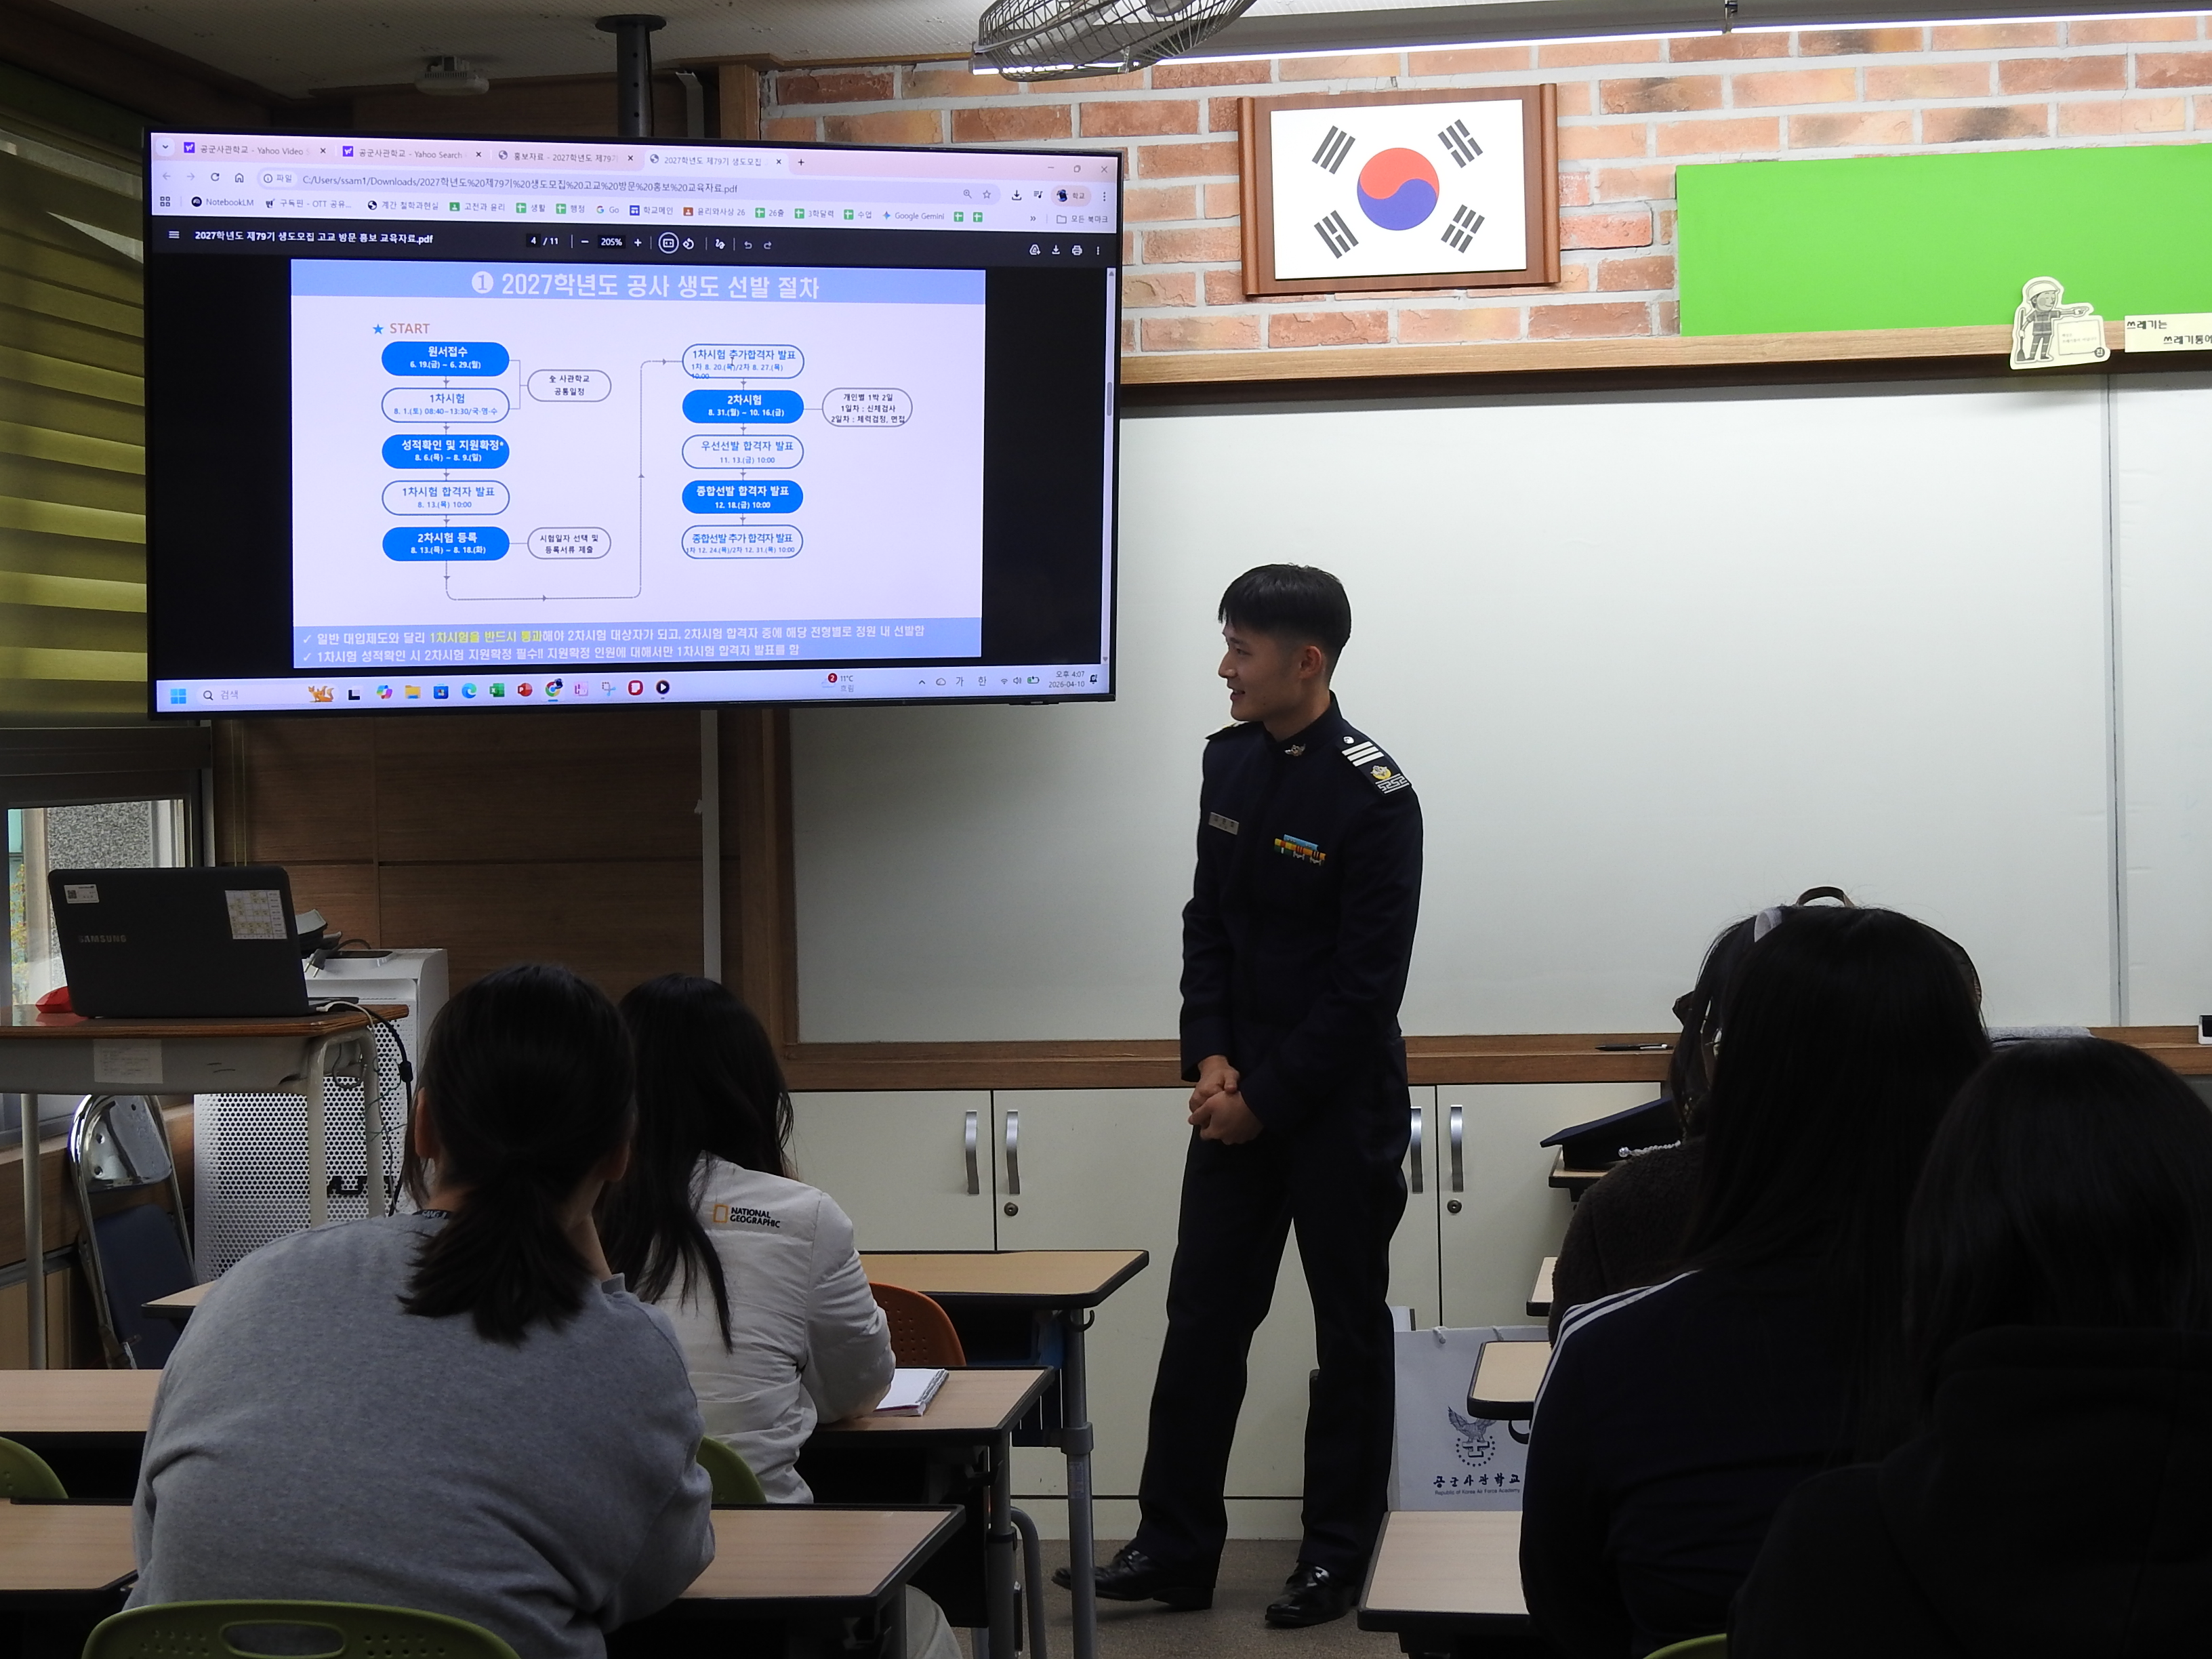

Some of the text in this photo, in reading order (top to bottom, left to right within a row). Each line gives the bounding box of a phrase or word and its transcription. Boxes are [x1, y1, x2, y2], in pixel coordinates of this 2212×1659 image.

[201, 145, 248, 155] 공군사관학교
[359, 149, 462, 159] 공군사관학교 Yahoo Search
[514, 152, 592, 163] 홍보자료 2027학년도
[665, 157, 761, 167] 2027학년도 제79기 생도모집
[276, 174, 291, 183] 파일
[382, 201, 397, 209] 계간
[644, 207, 673, 215] 학교메인
[895, 212, 919, 222] Google
[1088, 216, 1108, 224] 북마크
[195, 230, 433, 245] 2027학년도 제79기 생도모집 고교 방문 홍보 교육자료.pdf
[601, 238, 622, 246] 205%
[502, 272, 819, 300] 2027학년도 공사 생도 선발 절차
[390, 323, 430, 333] START
[2127, 320, 2167, 329] 쓰레기는
[428, 346, 468, 358] 원서접수
[693, 349, 796, 360] 1차시험 추가합격자 발표
[560, 375, 590, 383] 사관학교
[554, 388, 584, 396] 공통일정
[430, 393, 465, 404] 1차시험
[728, 394, 762, 405] 2차시험
[891, 415, 905, 424] 면접
[402, 440, 442, 451] 성적확인
[446, 440, 455, 451] 및
[701, 441, 794, 451] 우선선발 합격자 발표
[403, 487, 495, 497] 1차시험 합격자 발표
[697, 485, 789, 497] 종합선발 합격자 발표
[417, 532, 477, 544] 2차시험 등록
[693, 533, 727, 544] 종합선발
[748, 533, 774, 544] 합격자
[776, 533, 793, 544] 발표
[317, 633, 340, 645] 일반
[344, 632, 400, 645] 대입제도와
[404, 632, 425, 644] 달리
[430, 632, 480, 644] 1차시험을
[484, 630, 516, 642] 반드시
[520, 630, 565, 642] 통과해야
[568, 630, 606, 642] 2차시험
[611, 629, 653, 641] 대상자가
[684, 628, 722, 640] 2차시험
[726, 628, 758, 639] 합격자
[762, 627, 782, 639] 중에
[786, 627, 807, 638] 해당
[857, 626, 876, 638] 정원
[881, 626, 890, 637] 내
[895, 625, 924, 637] 선발함
[318, 651, 356, 663] 1차시험
[362, 650, 405, 663] 성적확인
[410, 650, 420, 661] 시
[425, 649, 464, 661] 2차시험
[469, 649, 512, 661] 지원확정
[548, 647, 590, 659] 지원확정
[595, 647, 626, 659] 인원에
[630, 646, 674, 658] 대해서만
[678, 645, 714, 657] 1차시험
[719, 645, 750, 657] 합격자
[754, 644, 785, 656] 발표를
[790, 644, 799, 655] 함
[956, 676, 964, 687] 가
[978, 676, 987, 687] 한
[840, 684, 854, 693] 흐림
[221, 690, 239, 700] 검색
[731, 1207, 771, 1218] NATIONAL
[730, 1214, 780, 1228] GEOGRAPHIC
[1433, 1473, 1520, 1488] 공군사관학교
